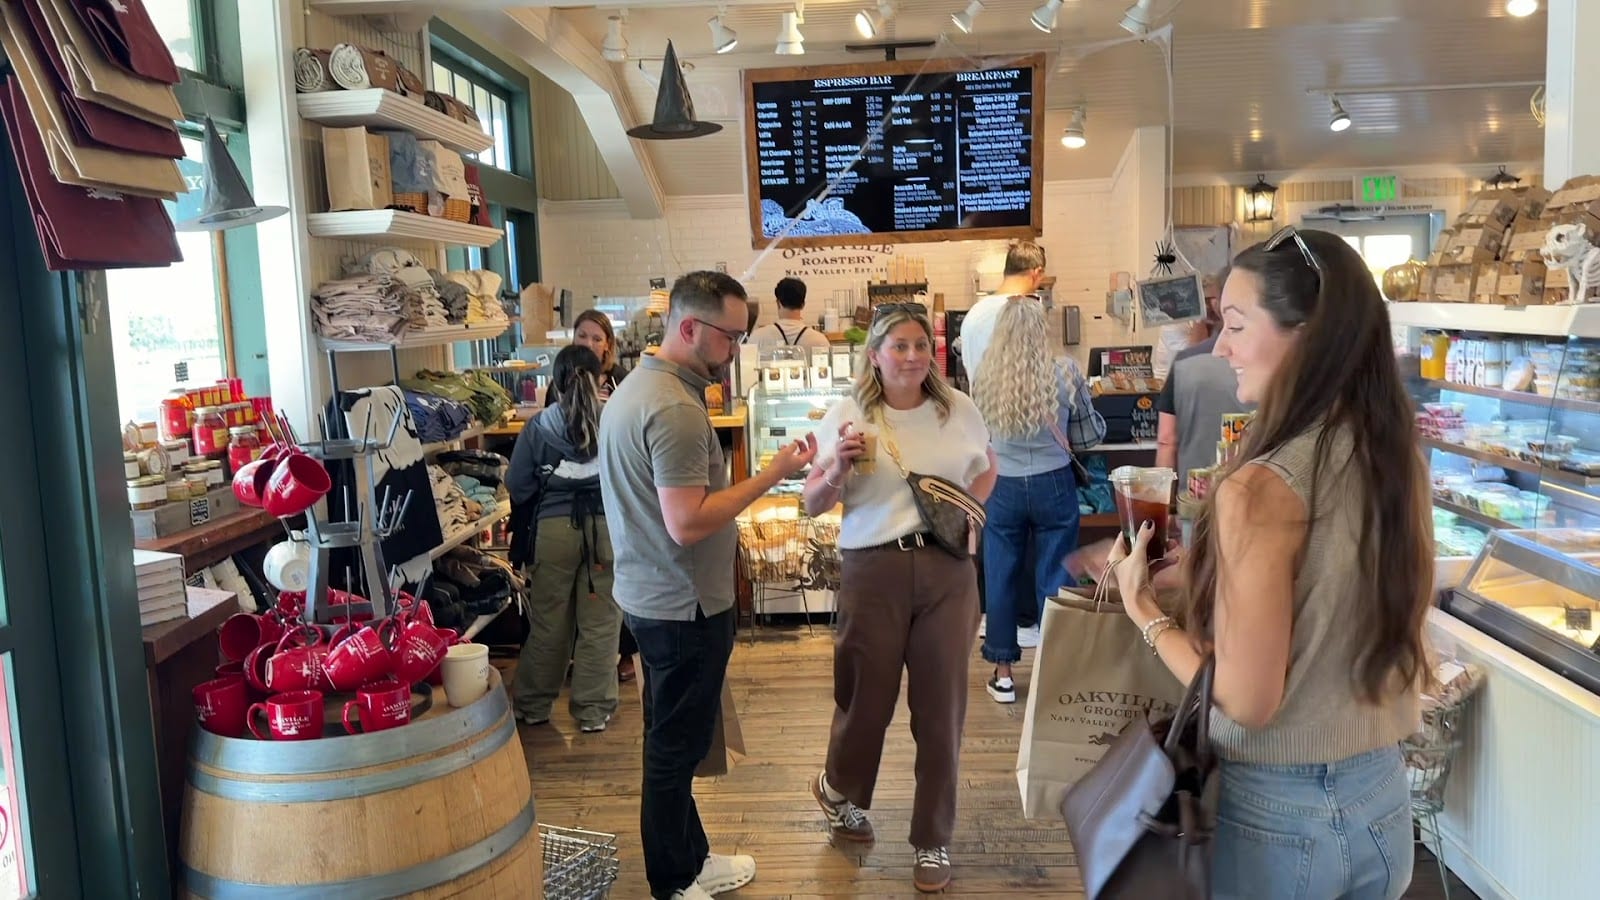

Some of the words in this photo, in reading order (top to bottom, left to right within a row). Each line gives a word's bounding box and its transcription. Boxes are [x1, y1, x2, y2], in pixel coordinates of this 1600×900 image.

[814, 76, 867, 88] ESPRESSO
[869, 75, 892, 85] BAR
[956, 70, 1020, 82] BREAKFAST
[1363, 176, 1396, 201] EXIT
[801, 255, 875, 266] ROASTERY
[1058, 691, 1177, 713] OAKVILLE
[1084, 705, 1141, 719] GROCE
[1050, 714, 1075, 724] NAPA
[1080, 717, 1116, 728] VALLEY
